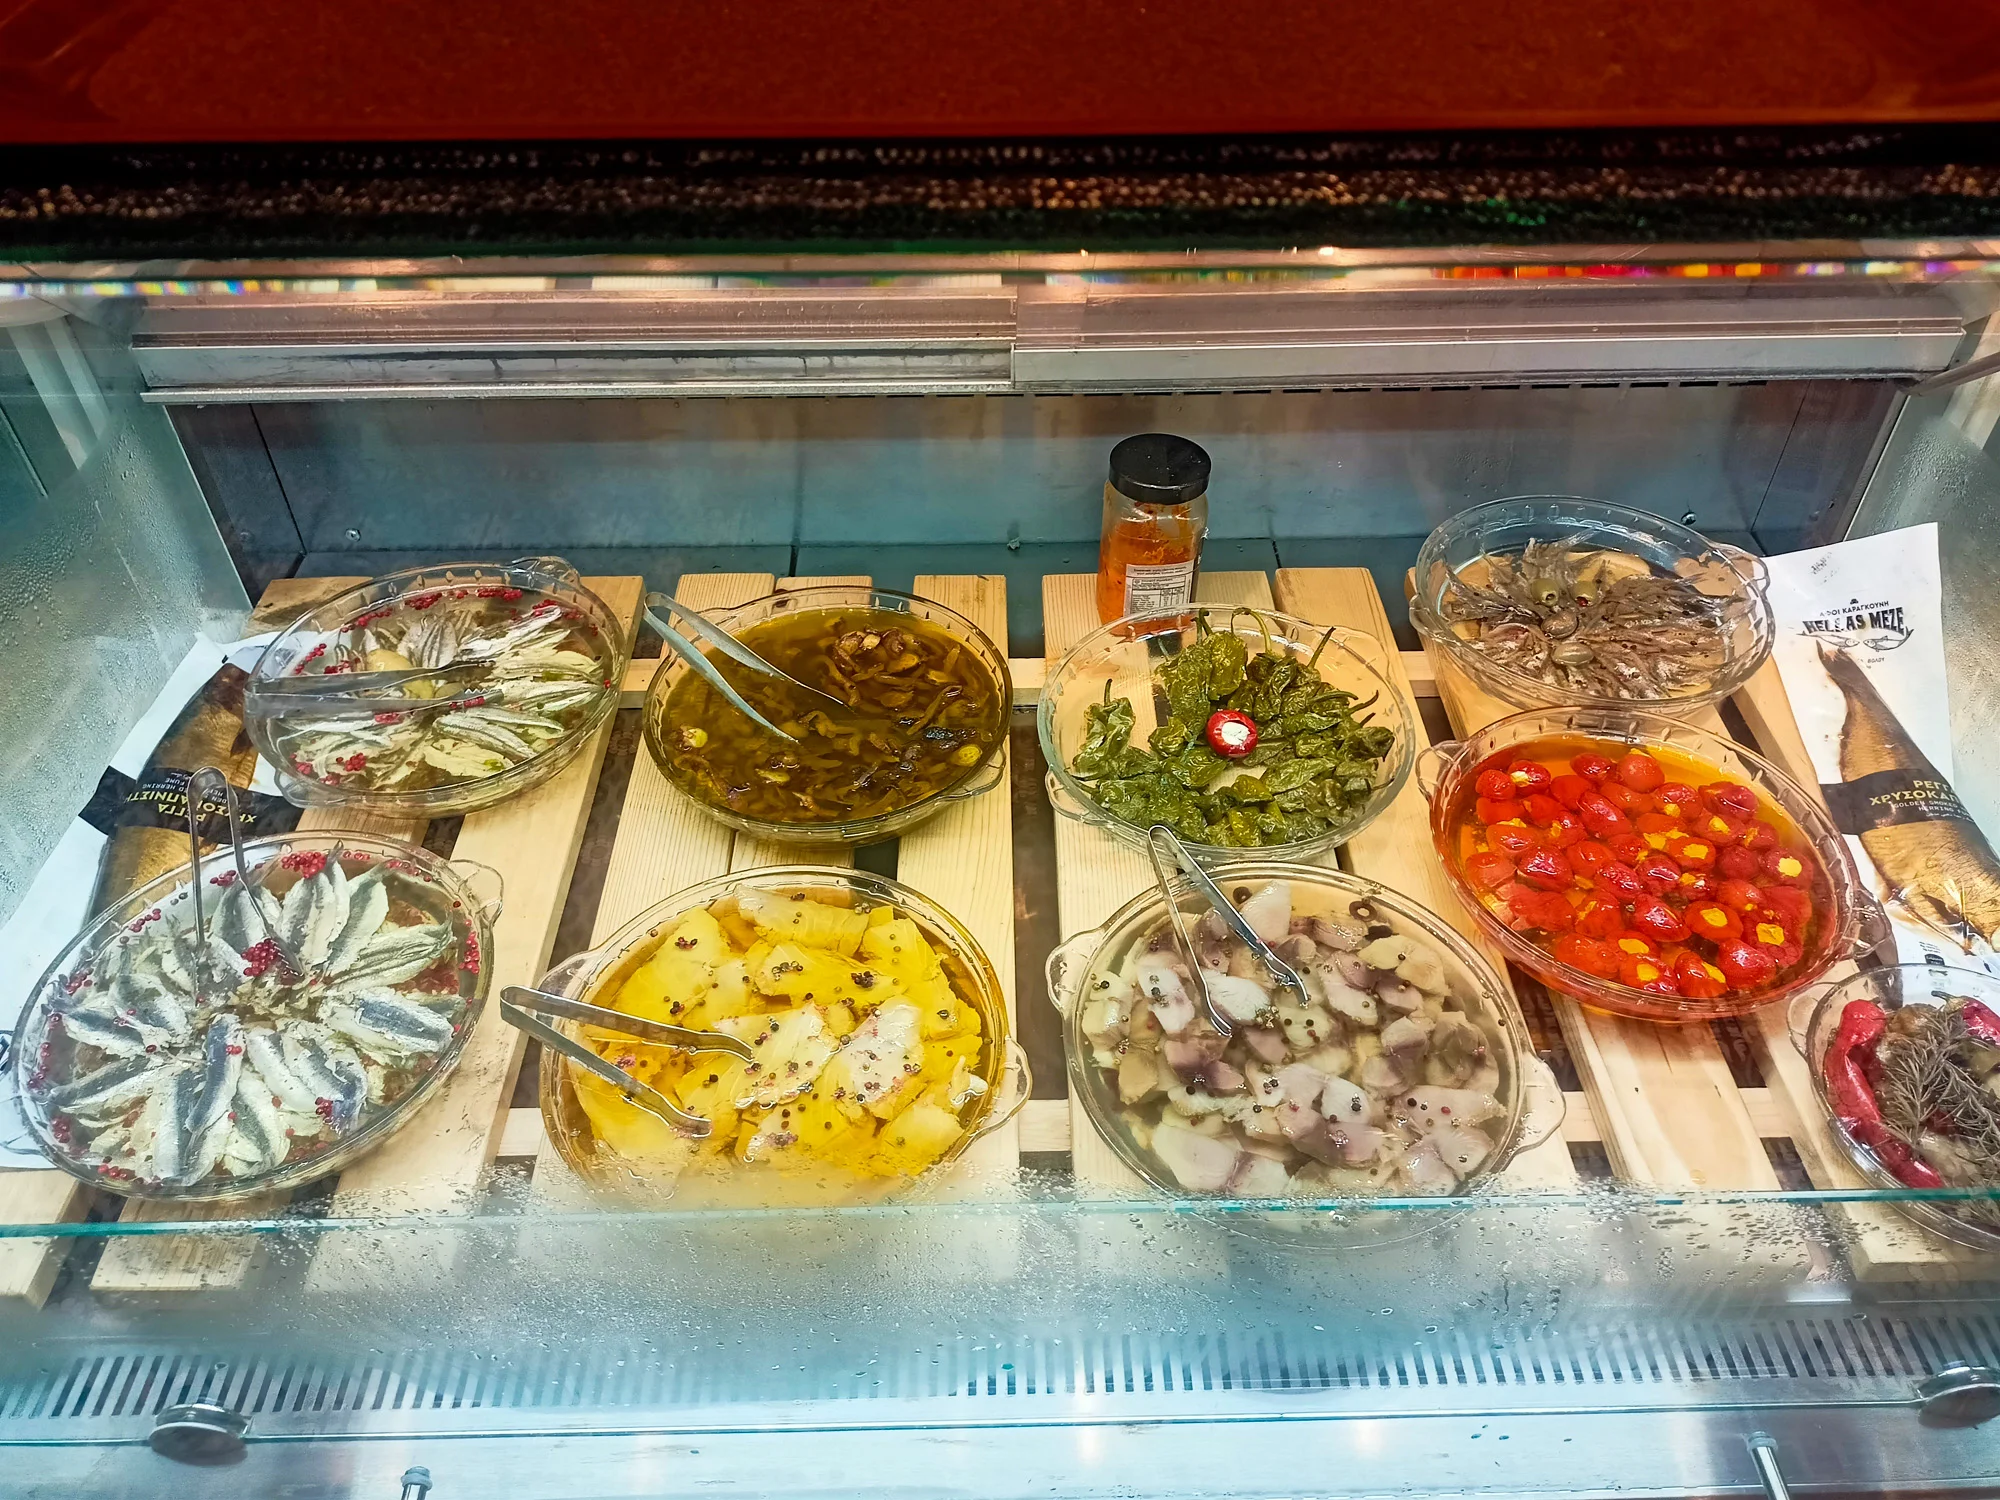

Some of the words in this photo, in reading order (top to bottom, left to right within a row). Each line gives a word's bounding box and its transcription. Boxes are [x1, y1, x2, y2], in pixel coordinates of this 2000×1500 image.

[1842, 600, 1889, 614] ΚΑΡΑΓΚΟΥΝΗ
[1868, 606, 1905, 636] MEZE
[141, 783, 176, 791] HERRING
